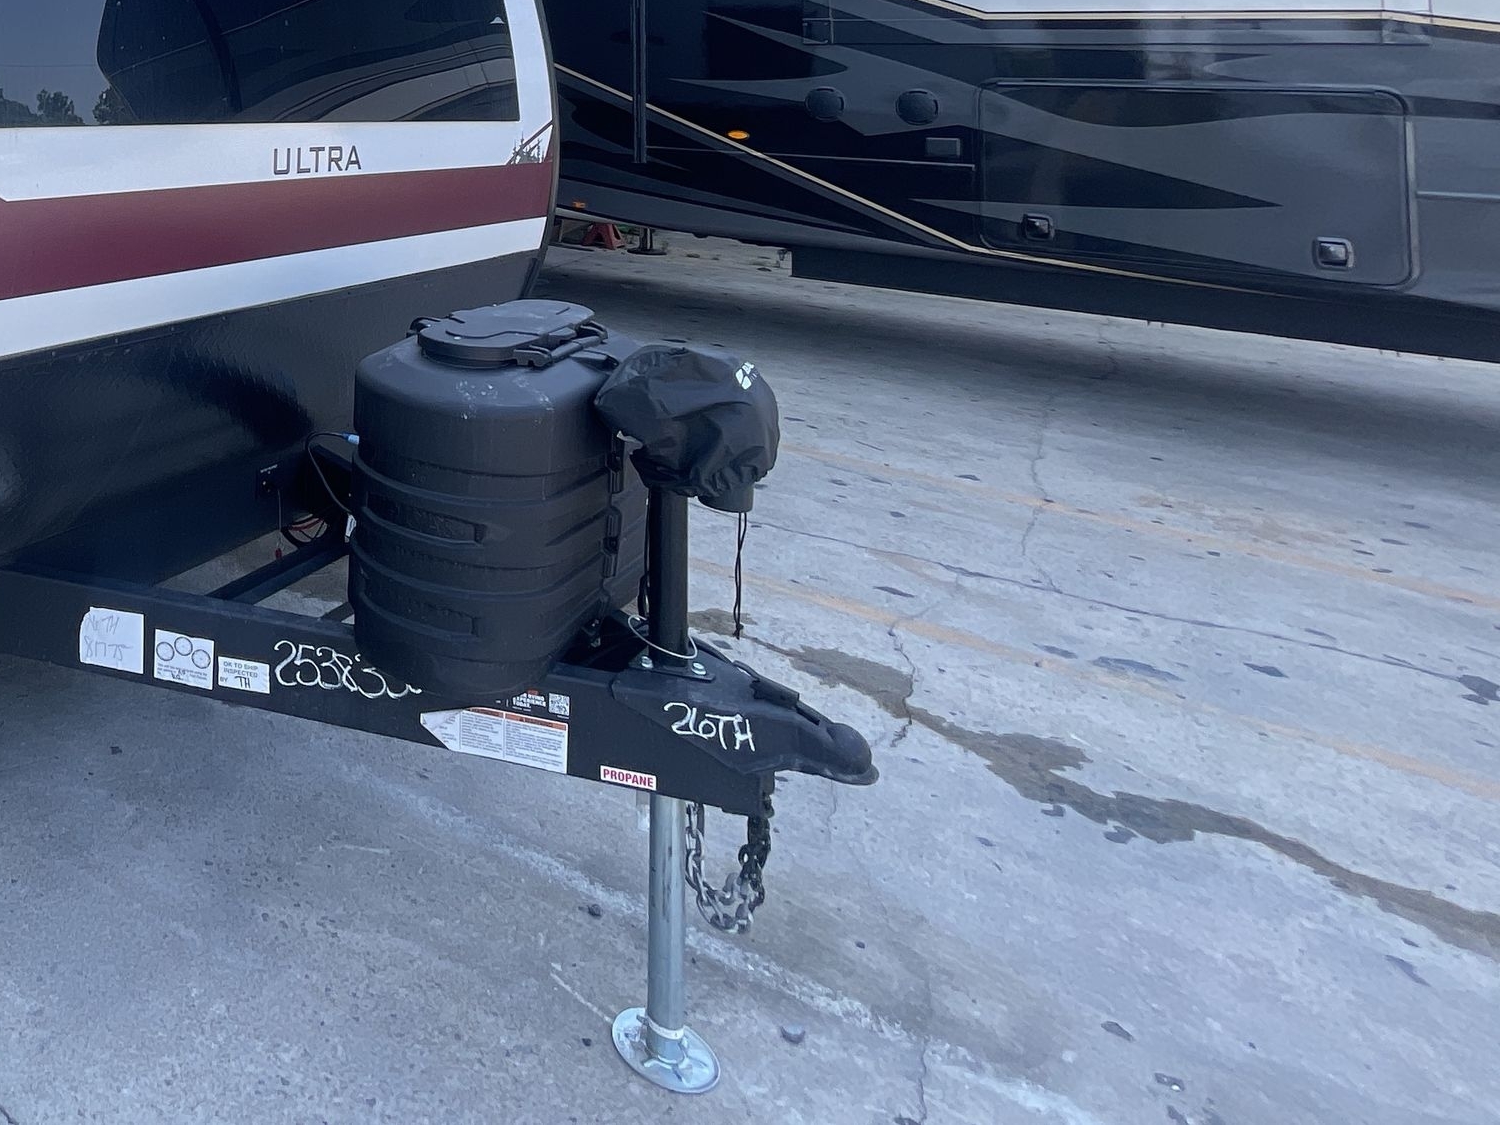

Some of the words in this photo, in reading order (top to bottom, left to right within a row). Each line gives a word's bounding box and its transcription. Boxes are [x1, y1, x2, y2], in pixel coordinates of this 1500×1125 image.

[272, 144, 363, 176] ULTRA
[223, 667, 259, 679] INSPECTED
[602, 767, 655, 789] PROPANE
